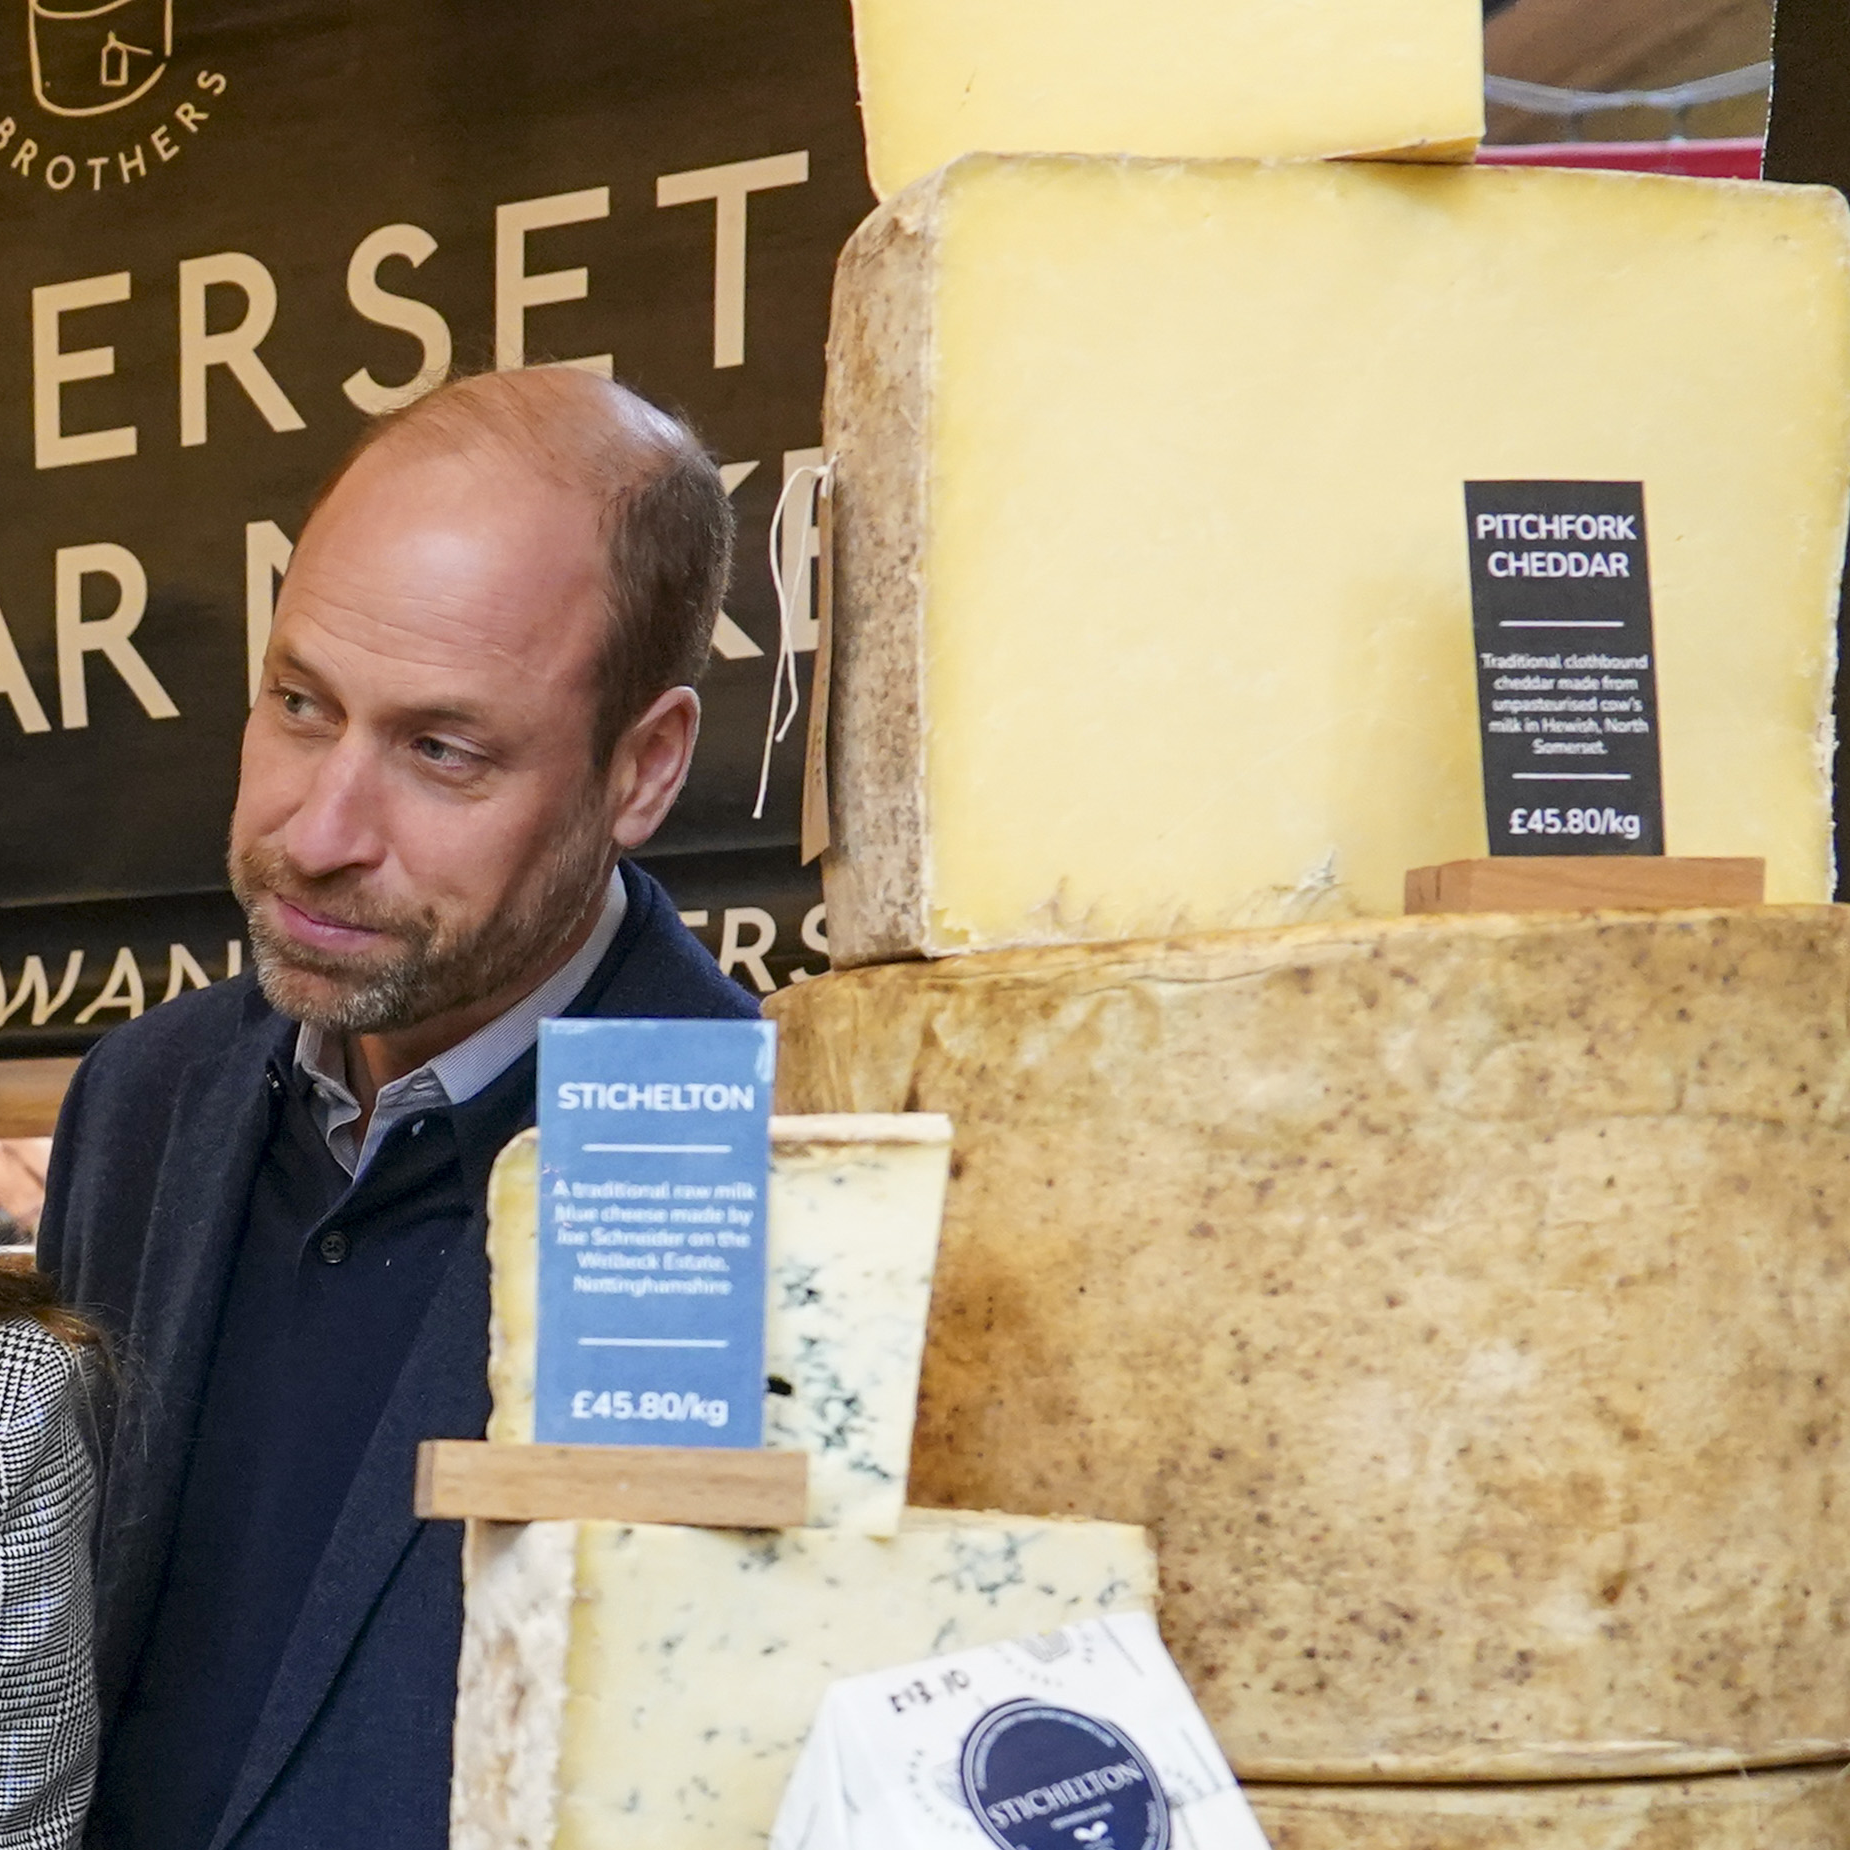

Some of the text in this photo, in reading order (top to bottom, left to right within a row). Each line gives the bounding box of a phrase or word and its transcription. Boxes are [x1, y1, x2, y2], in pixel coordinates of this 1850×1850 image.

[1476, 513, 1637, 541] PITCHFORK
[1487, 551, 1630, 578] CHEDDAR
[1480, 653, 1649, 670] Traditional clothbound
[1493, 675, 1639, 691] cheddar made from
[1492, 697, 1598, 714] unpasteurised
[1488, 717, 1522, 733] milk
[1524, 717, 1540, 733] in
[1603, 717, 1649, 733] North
[1509, 807, 1641, 840] £45.80/kg
[557, 1080, 755, 1113] STICHELTON
[552, 1179, 571, 1197] A
[572, 1181, 670, 1200] traditional
[714, 1181, 757, 1200] milk
[555, 1203, 754, 1227] blue cheese made by
[687, 1232, 716, 1247] on
[717, 1229, 752, 1248] the
[571, 1390, 730, 1429] £45.80/kg
